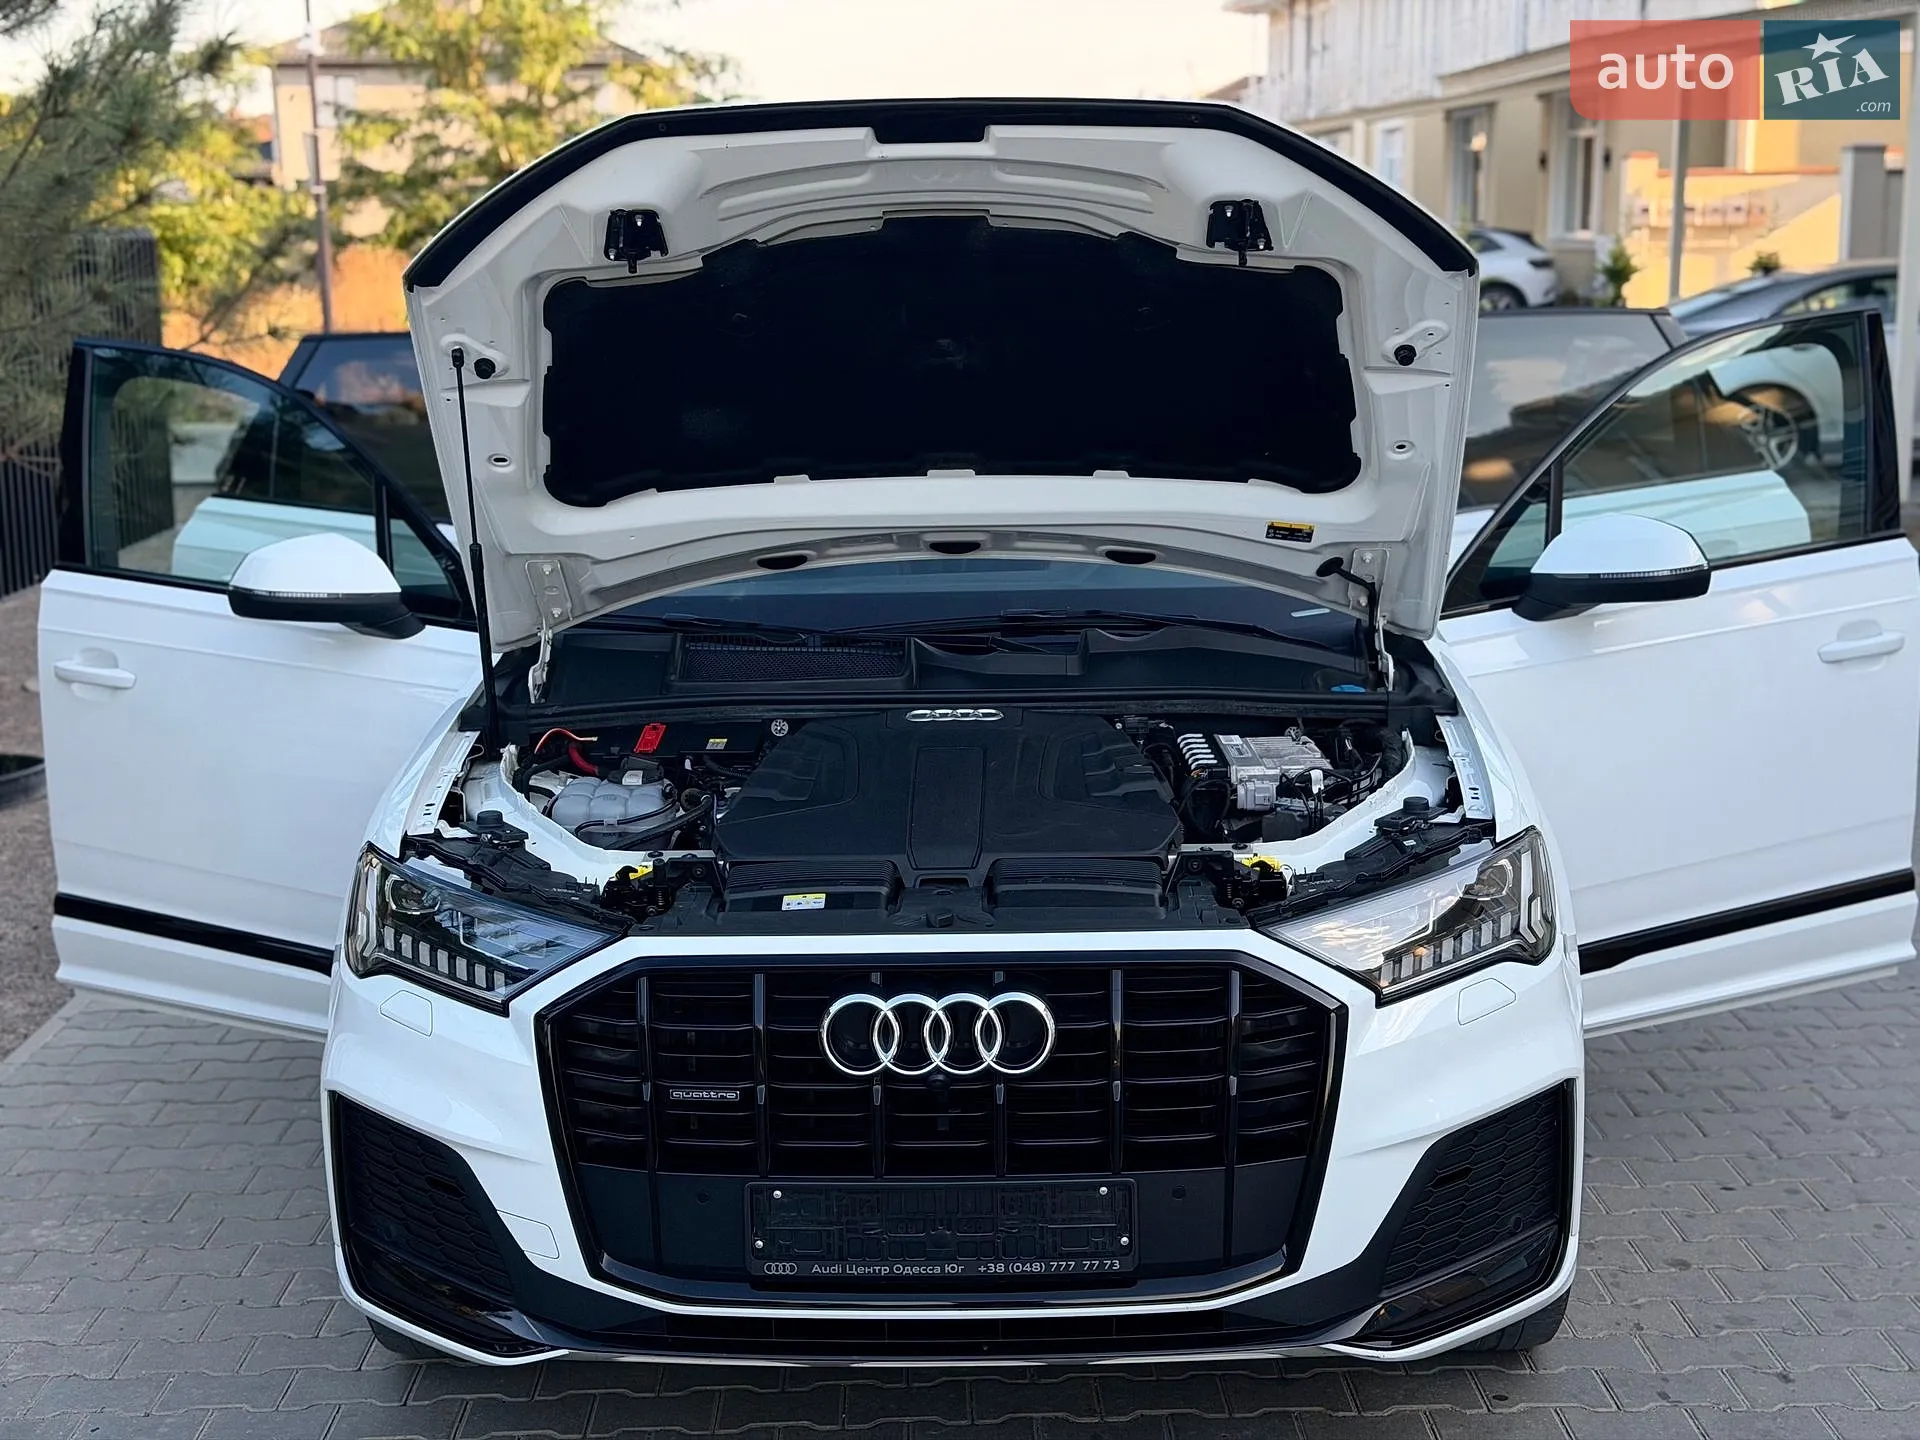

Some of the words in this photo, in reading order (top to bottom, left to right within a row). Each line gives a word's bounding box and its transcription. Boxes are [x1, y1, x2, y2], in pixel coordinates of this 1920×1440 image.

[672, 1091, 737, 1099] quattro
[811, 1263, 842, 1274] Audi
[846, 1264, 890, 1276] Центр
[893, 1264, 941, 1276] Одесса
[944, 1263, 965, 1274] Юг
[978, 1262, 1005, 1273] +38
[1008, 1262, 1046, 1274] (048)
[1050, 1261, 1076, 1272] 777
[1082, 1261, 1100, 1271] 77
[1103, 1260, 1121, 1270] 73
